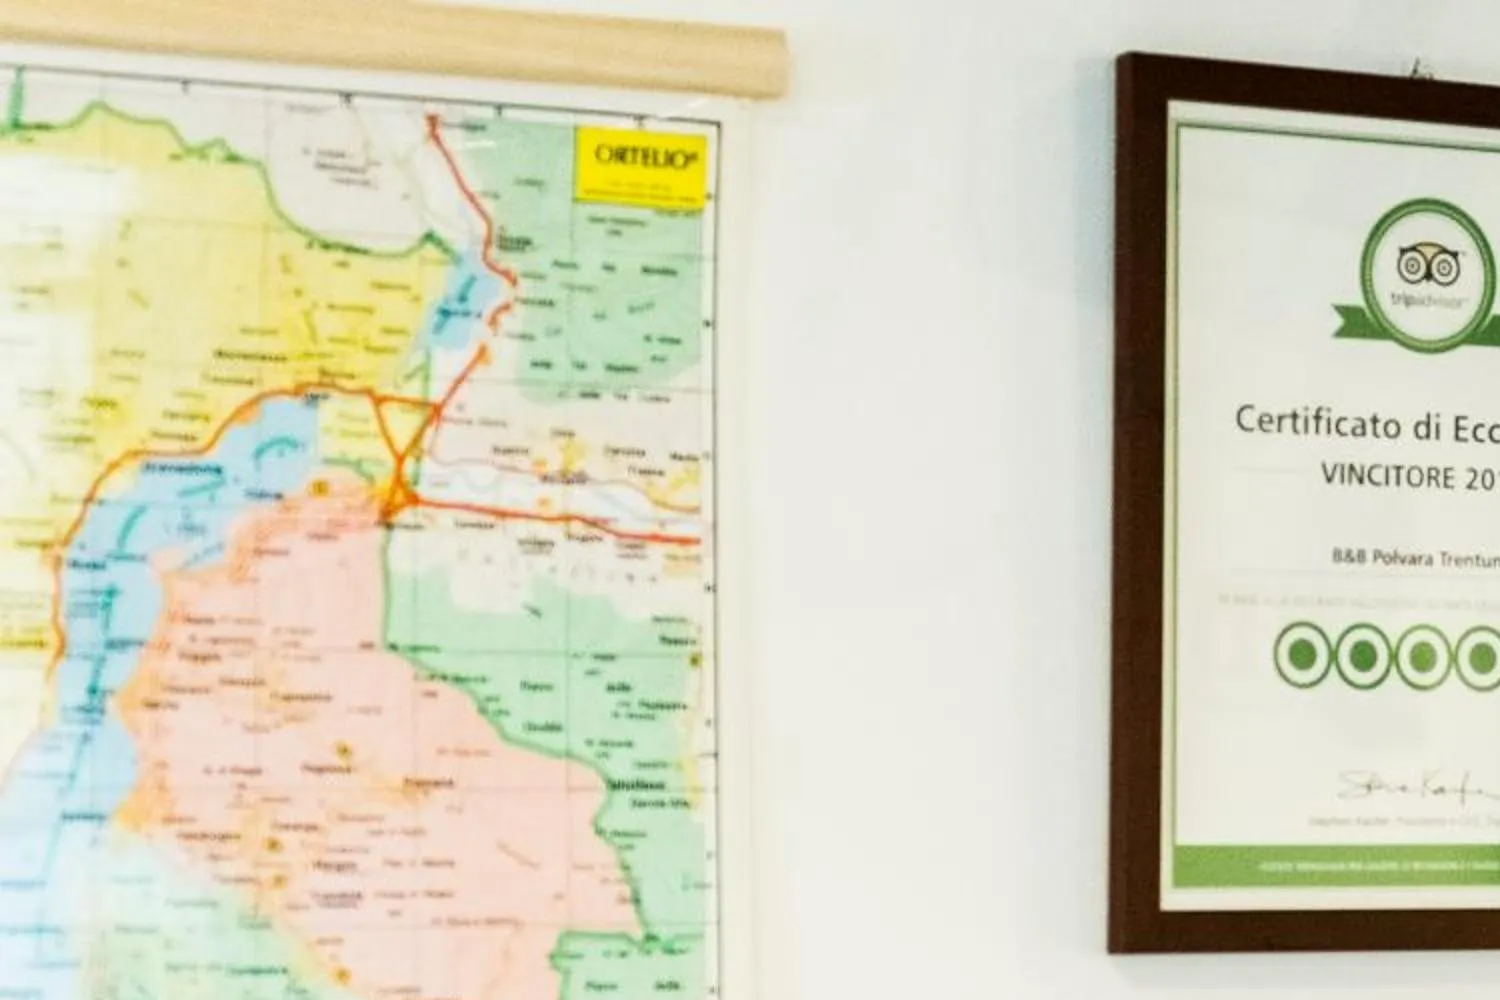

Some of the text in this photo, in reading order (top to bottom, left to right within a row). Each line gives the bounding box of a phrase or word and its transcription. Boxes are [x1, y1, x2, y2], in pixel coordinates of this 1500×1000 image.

[1236, 404, 1401, 440] Certificato
[1414, 412, 1441, 442] di
[1321, 461, 1455, 490] VINCITORE
[1332, 547, 1367, 565] B&B
[1373, 548, 1434, 568] Polvara
